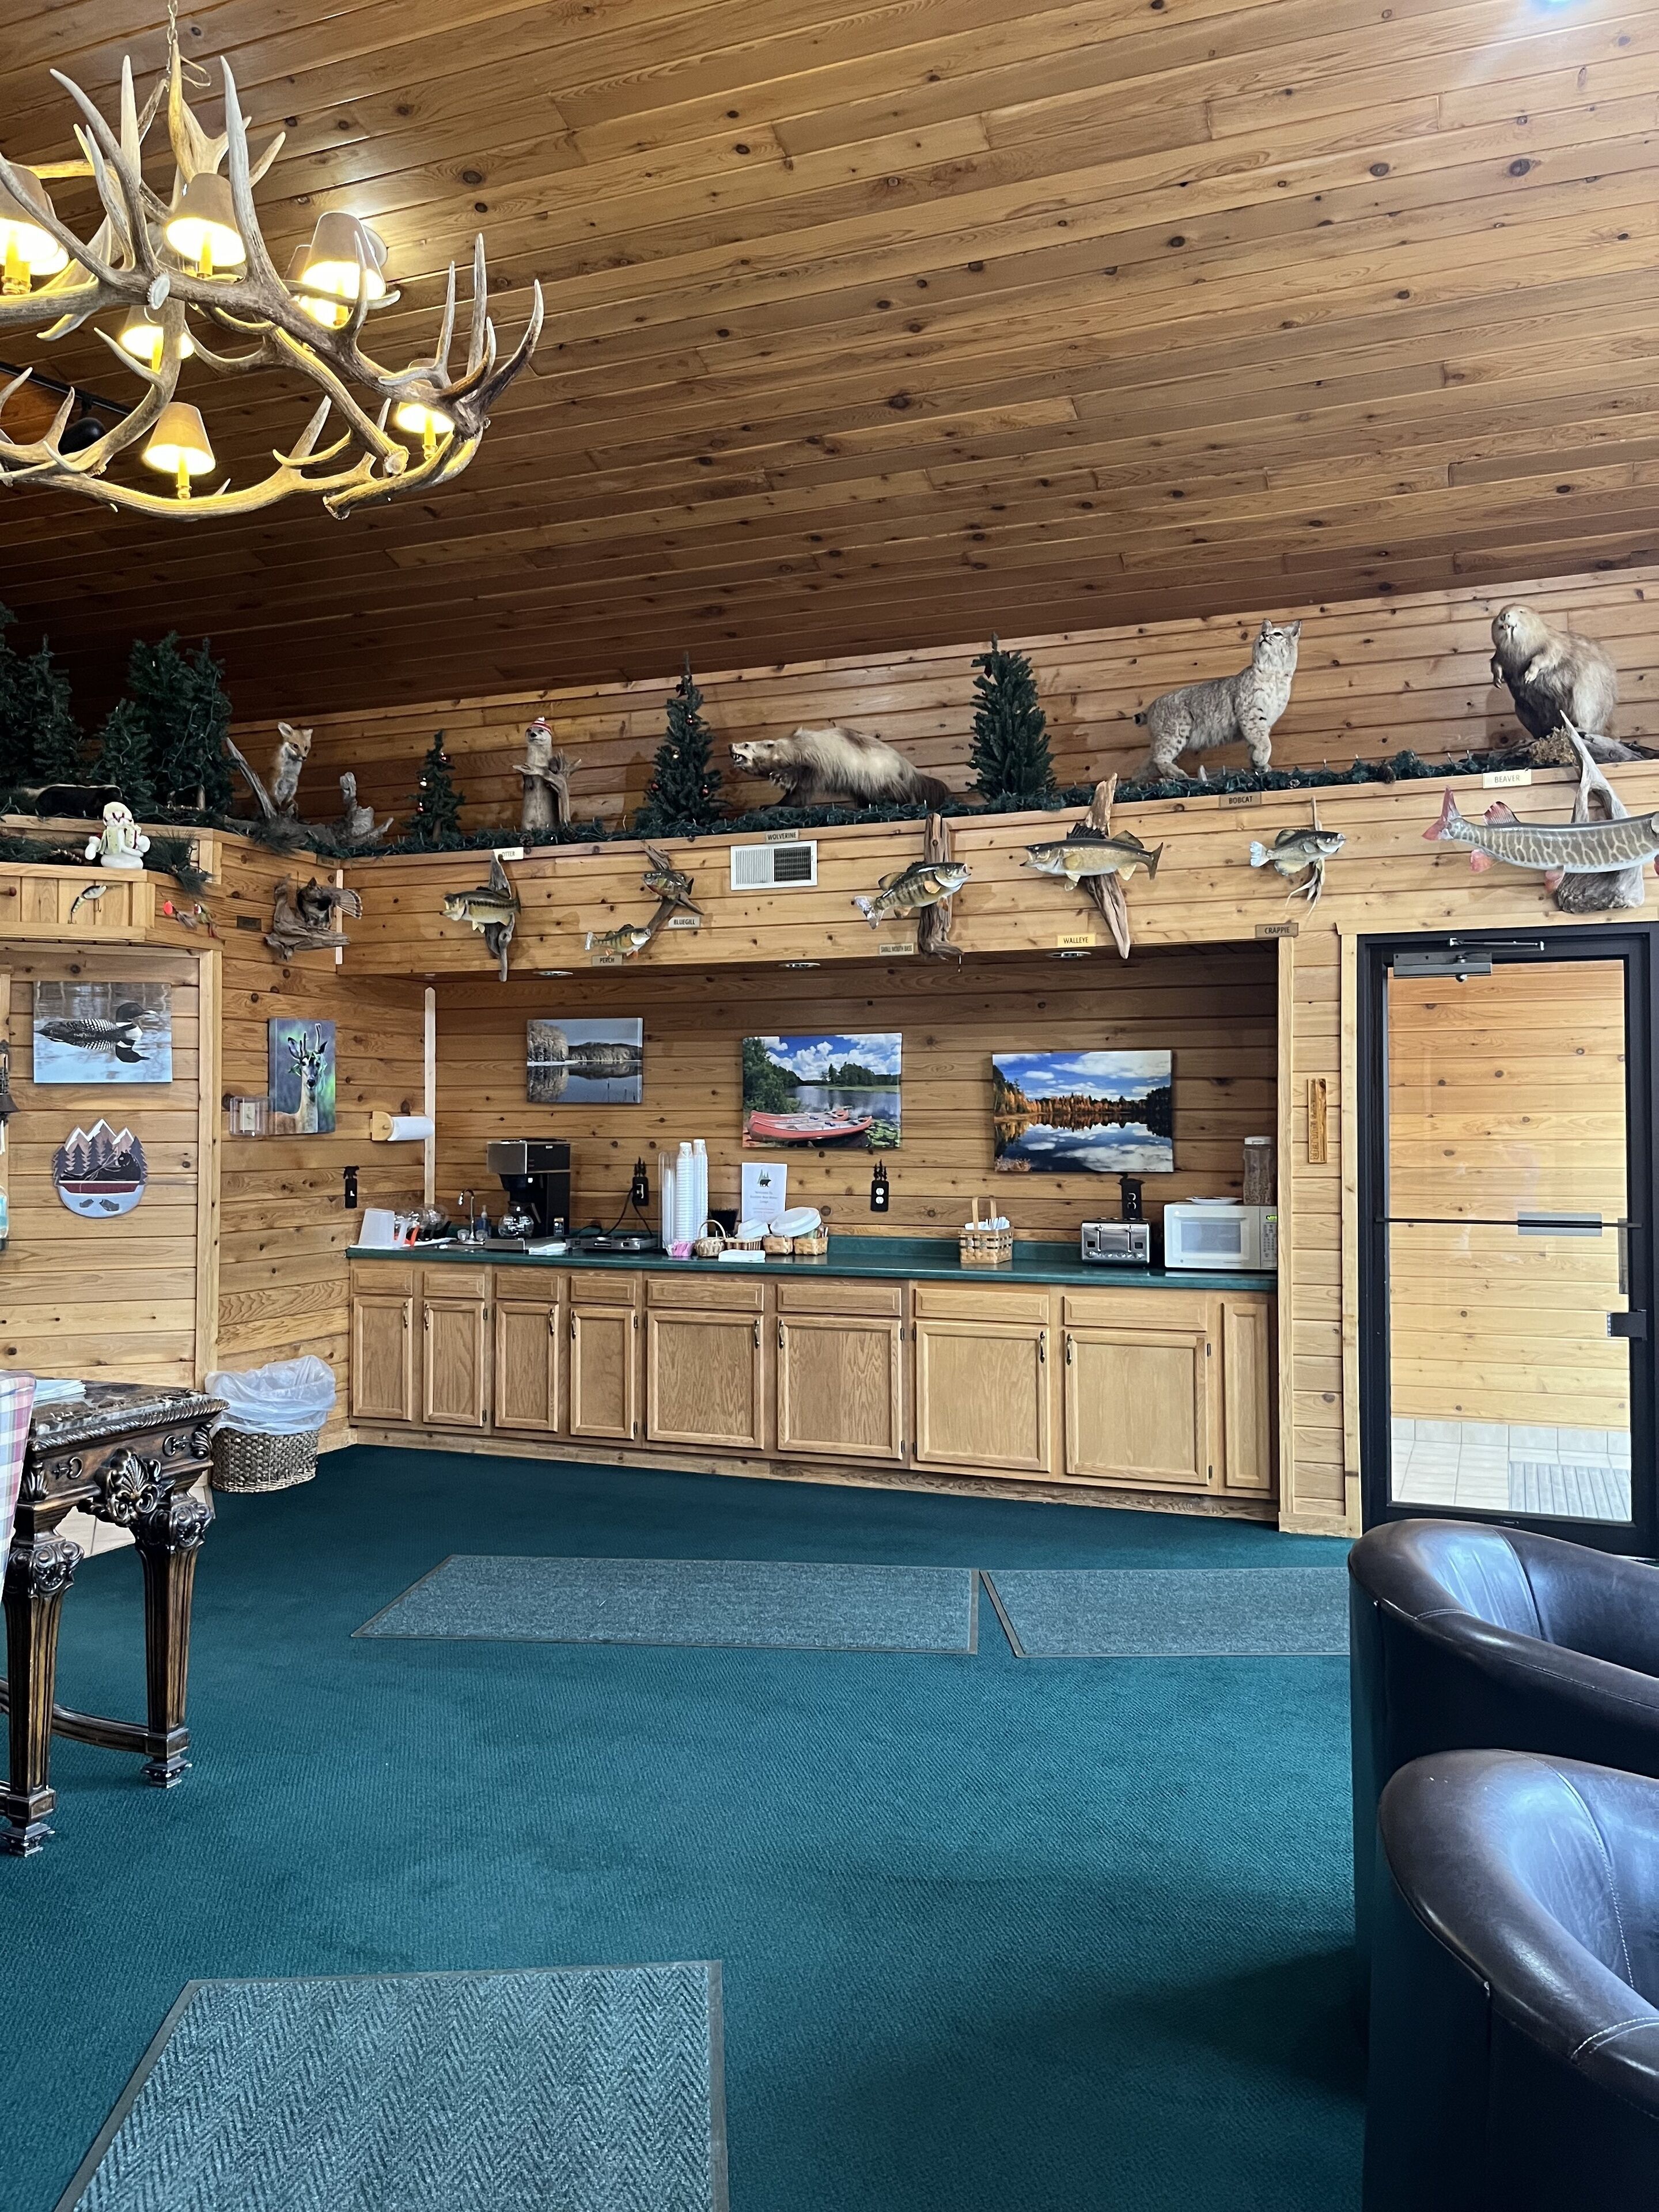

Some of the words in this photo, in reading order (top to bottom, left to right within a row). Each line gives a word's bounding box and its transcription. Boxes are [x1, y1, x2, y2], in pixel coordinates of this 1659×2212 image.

[1494, 775, 1520, 783] BEAVER
[1229, 796, 1253, 804] BOBCAT
[767, 832, 796, 840] WOLVERINE
[1264, 926, 1290, 934] CRAPPIE
